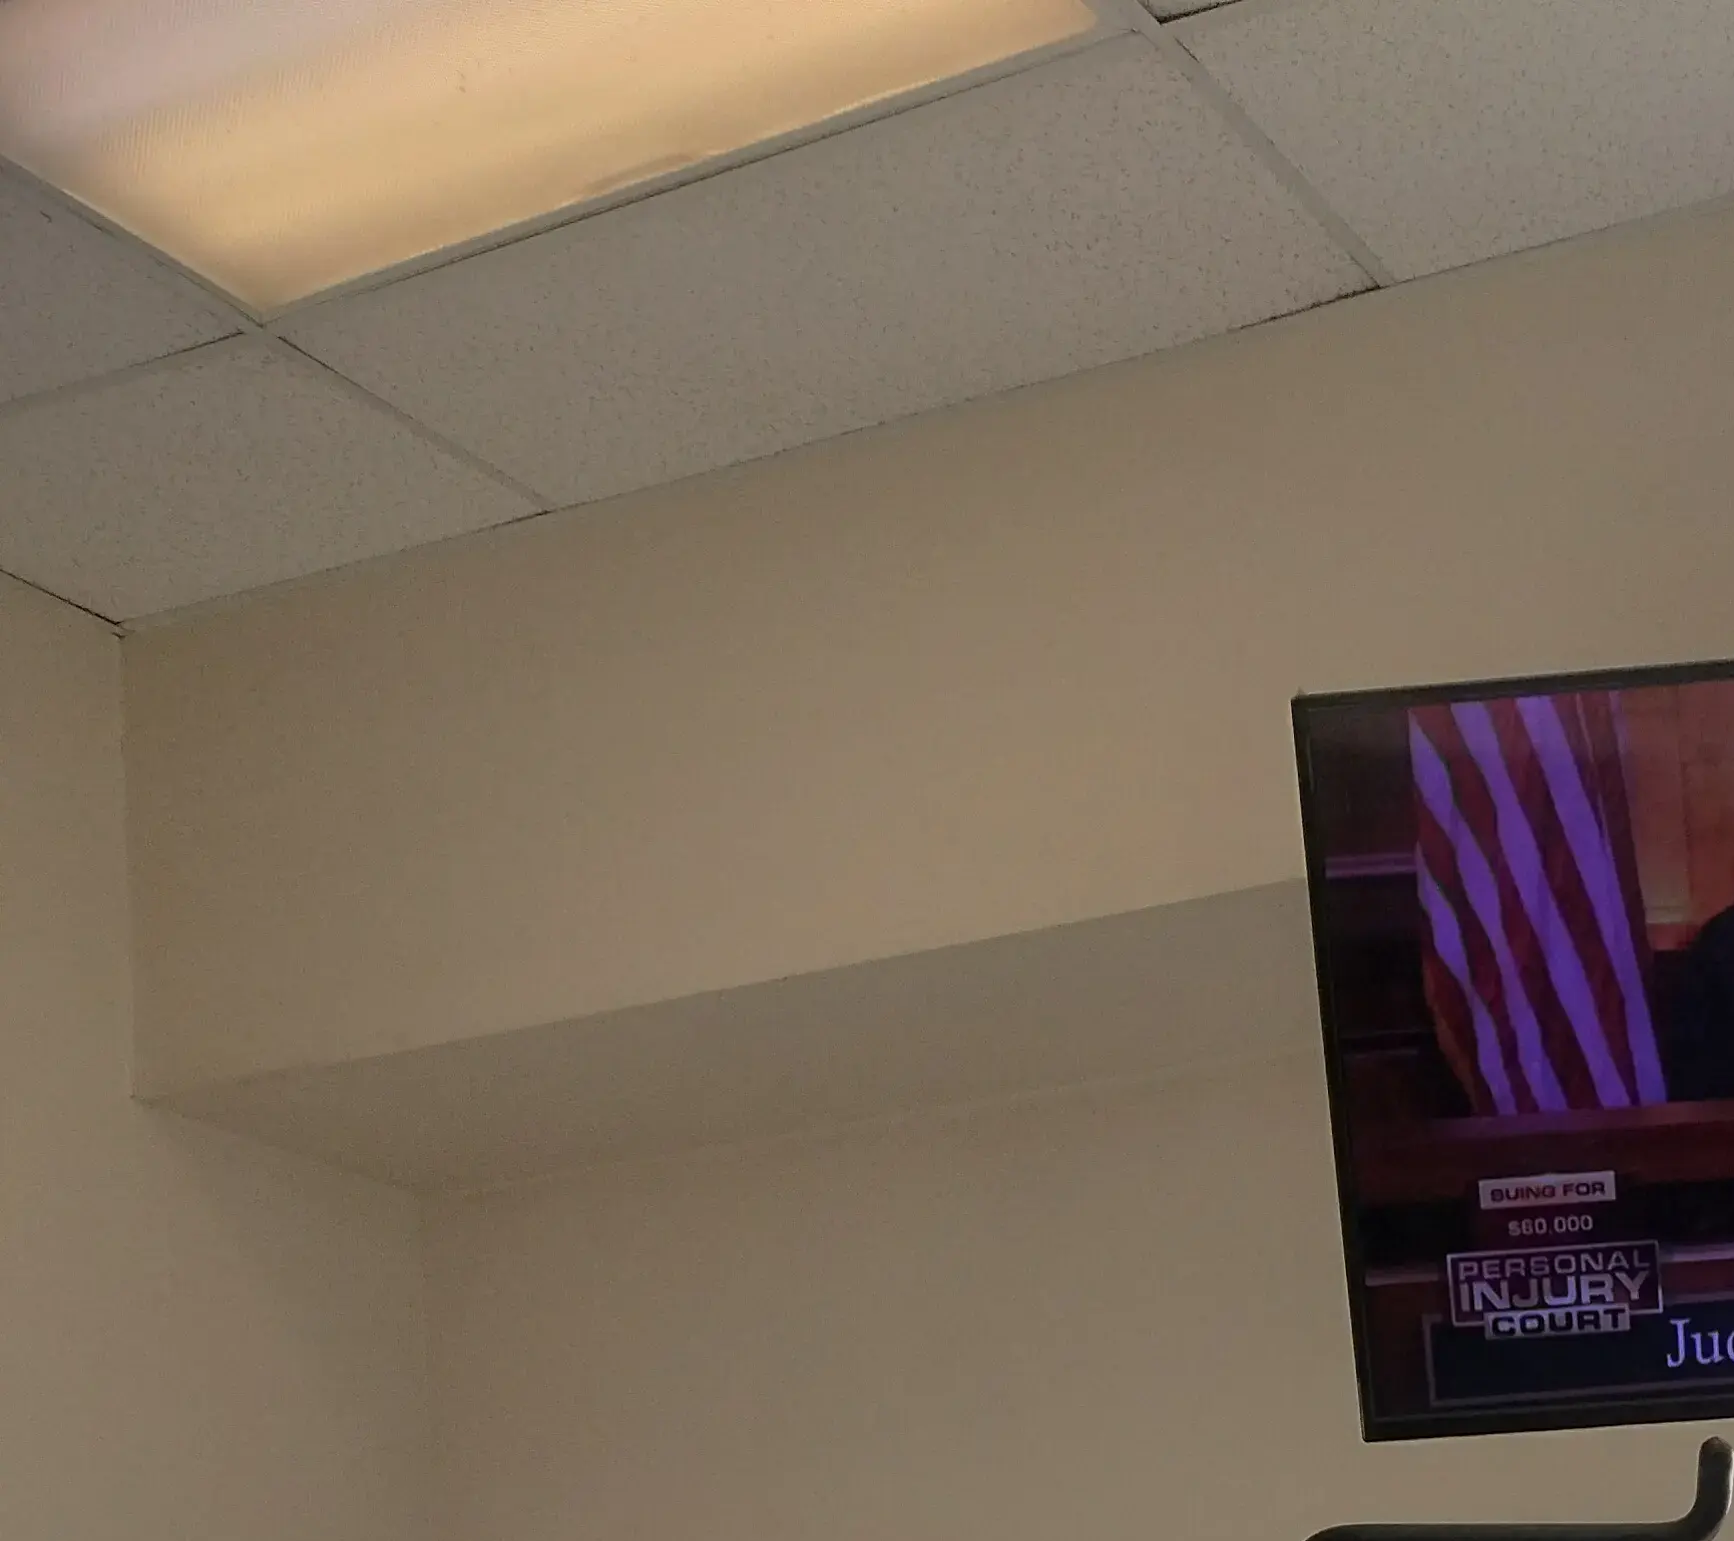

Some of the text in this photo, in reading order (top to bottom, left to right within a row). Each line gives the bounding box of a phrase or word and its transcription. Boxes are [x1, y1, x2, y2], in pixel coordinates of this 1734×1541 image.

[1562, 1181, 1606, 1198] FOR
[1458, 1249, 1651, 1281] PERSONAL
[1460, 1270, 1650, 1313] INJURY
[1491, 1308, 1627, 1338] COURT
